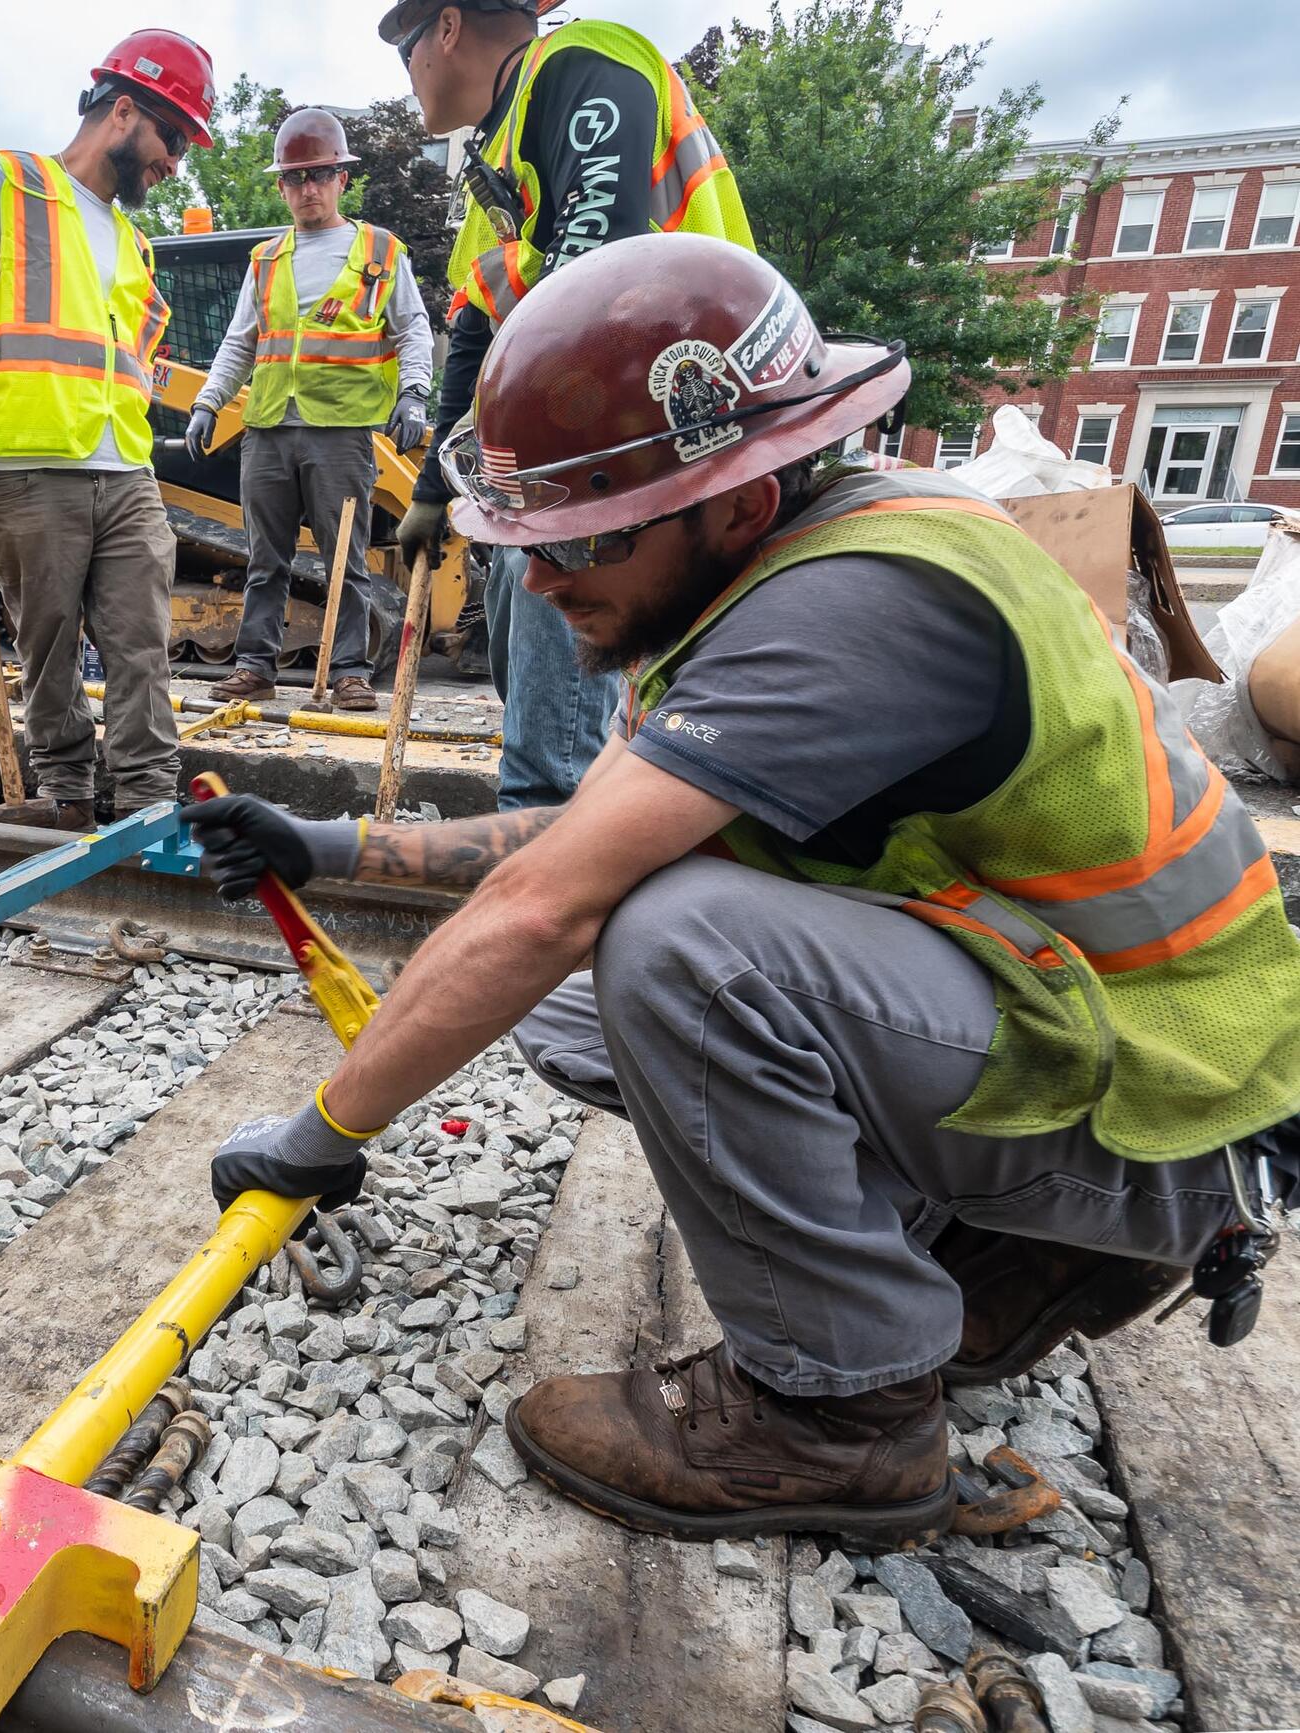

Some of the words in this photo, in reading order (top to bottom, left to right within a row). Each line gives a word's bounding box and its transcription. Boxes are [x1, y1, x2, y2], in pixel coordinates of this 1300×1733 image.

[653, 363, 670, 391] FUCK
[662, 344, 691, 364] YOUR
[692, 343, 719, 367] SUITS
[770, 345, 795, 376] THE
[683, 443, 711, 459] UNION
[655, 711, 719, 745] FORCE
